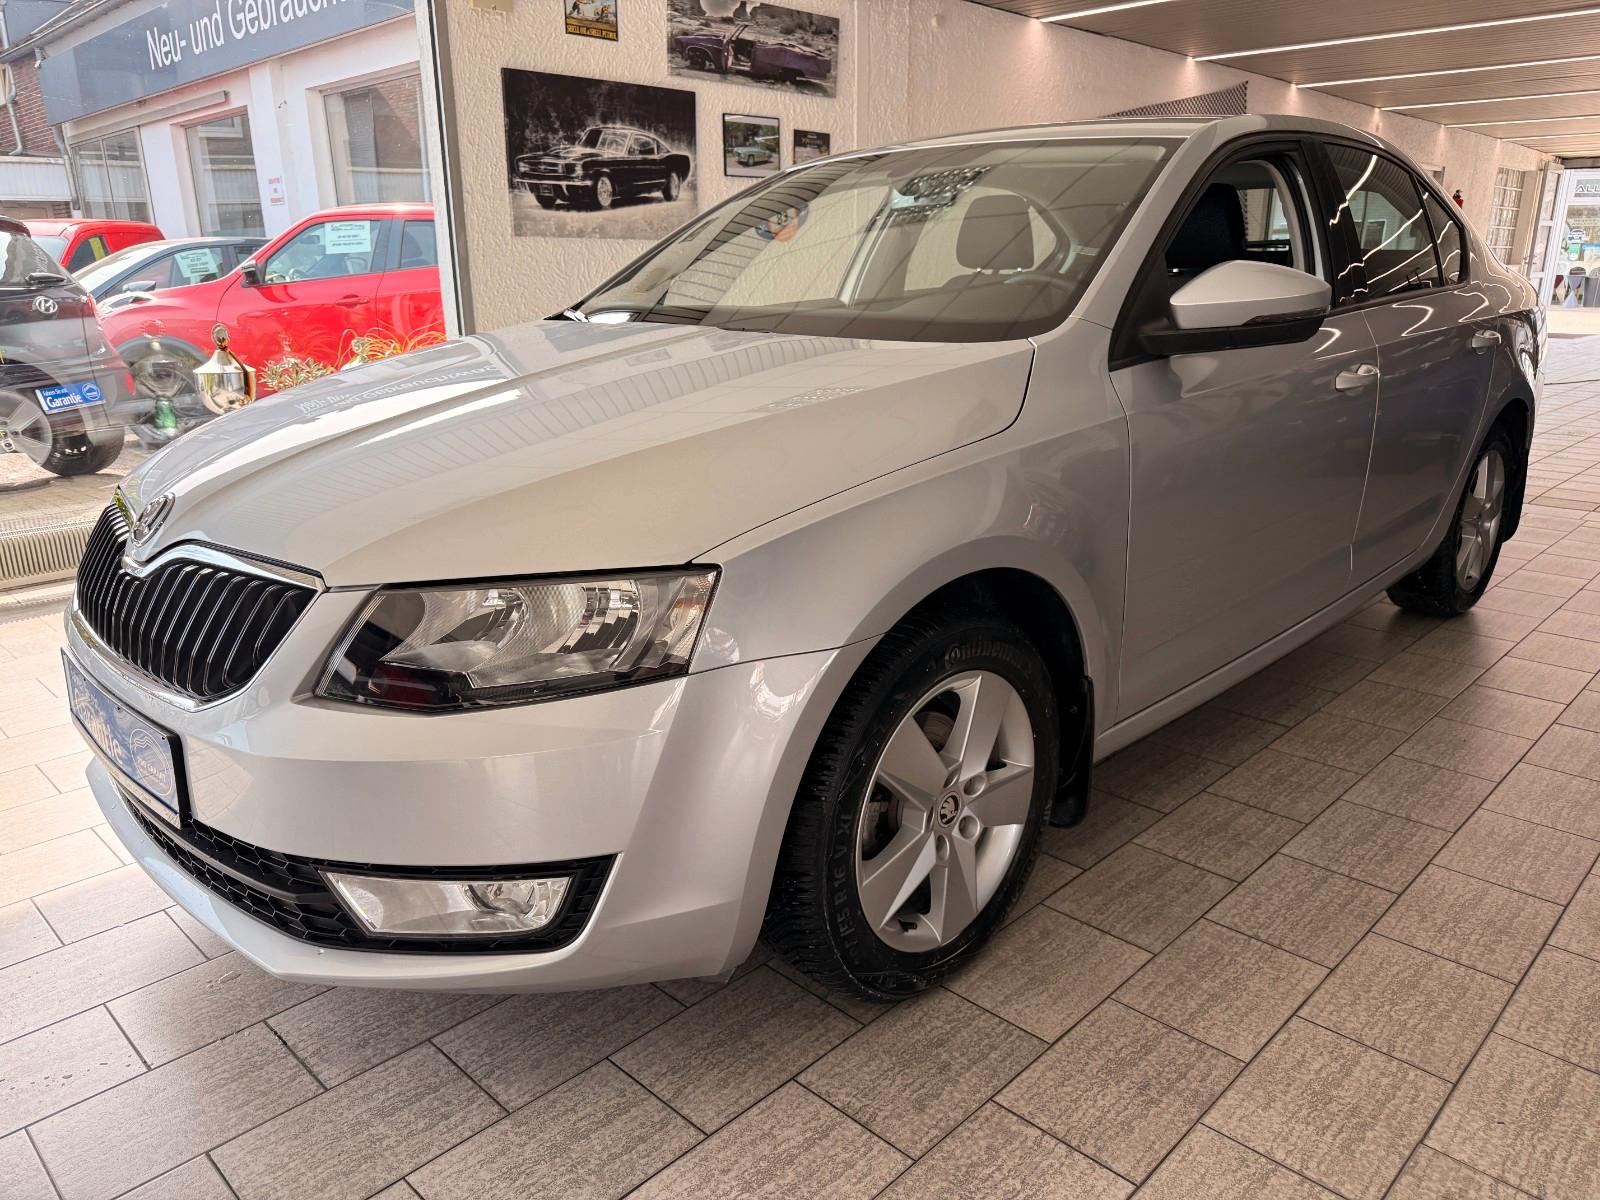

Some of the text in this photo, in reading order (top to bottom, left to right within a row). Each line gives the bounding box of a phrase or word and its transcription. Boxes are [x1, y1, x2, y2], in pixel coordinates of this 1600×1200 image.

[146, 0, 347, 71] Neu- und Gebrau
[46, 393, 83, 407] Garantie
